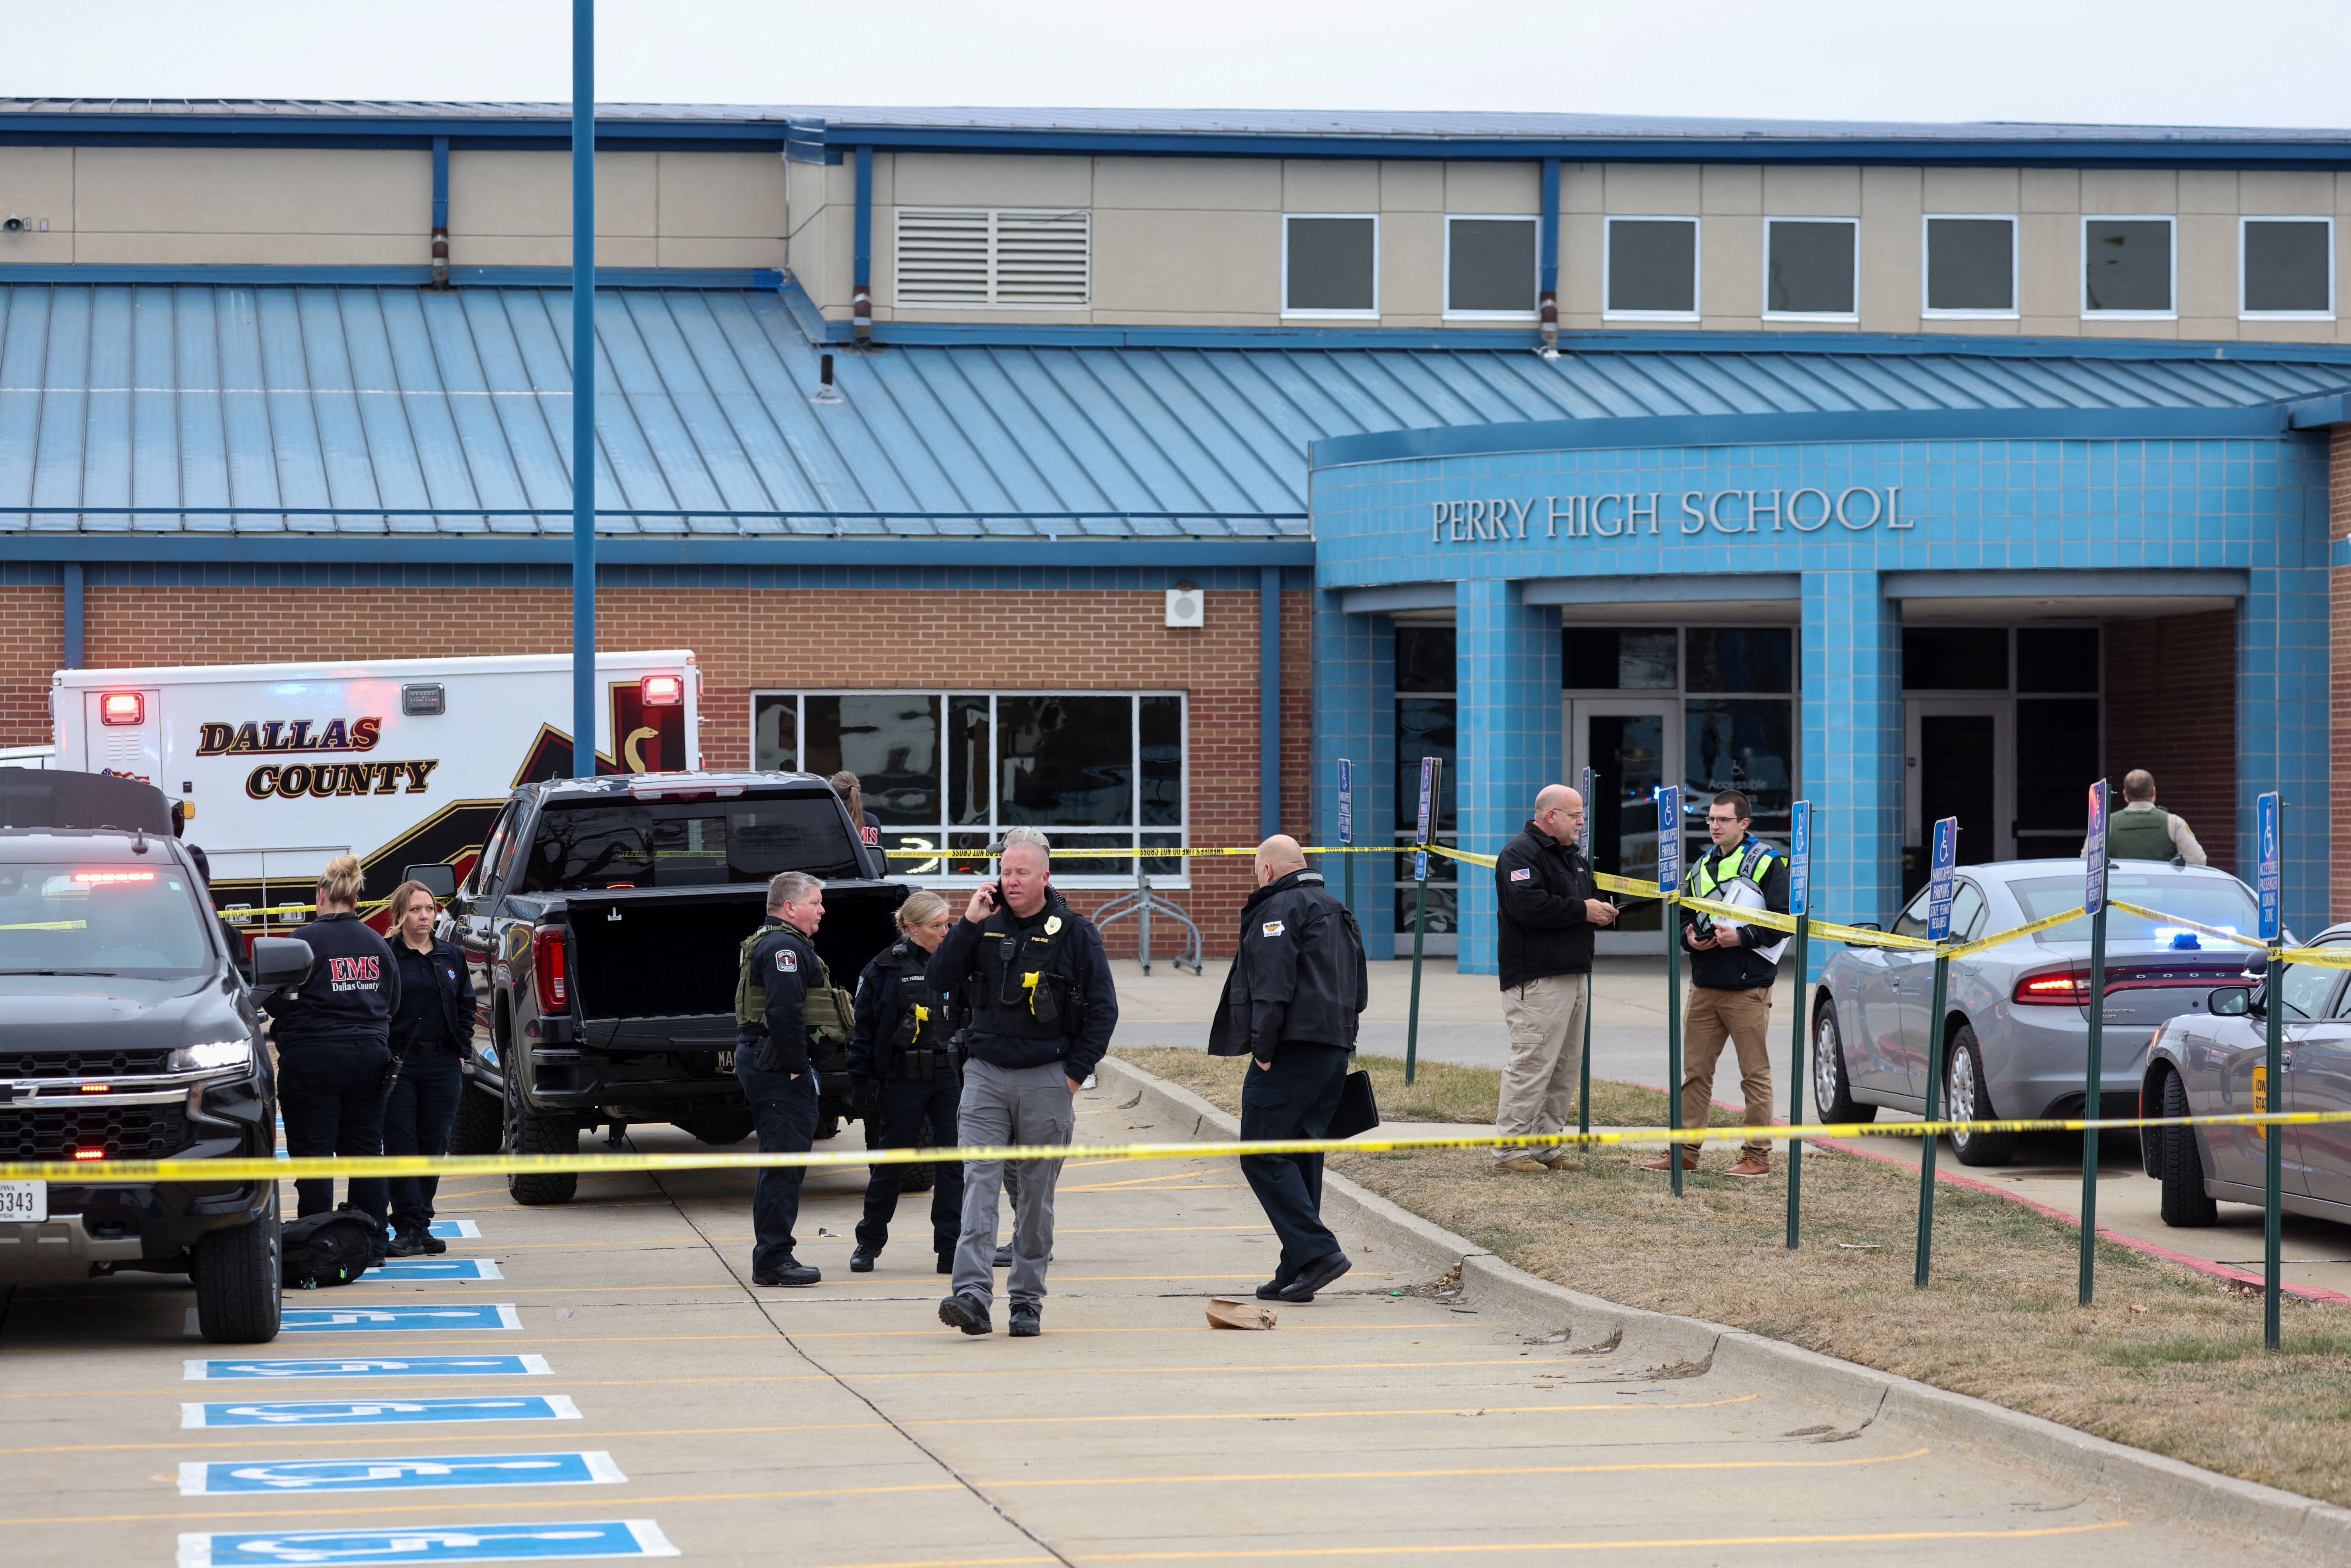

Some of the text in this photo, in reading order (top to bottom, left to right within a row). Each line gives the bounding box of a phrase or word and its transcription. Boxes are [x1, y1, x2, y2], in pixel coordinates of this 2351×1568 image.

[1432, 486, 1914, 542] PERRY HIGH SCHOOL
[196, 717, 382, 756] DALLAS
[246, 759, 439, 800] COUNTY
[1709, 779, 1768, 790] Accessible
[1660, 828, 1677, 843] HANDICAPPED
[1662, 843, 1676, 857] PARKING
[1669, 860, 1678, 871] PERMIT
[1743, 848, 1761, 874] EMA
[2090, 851, 2102, 870] PARKING
[1932, 865, 1953, 883] HANDICAPPED
[2260, 861, 2278, 876] ACCESSIBLE
[1662, 871, 1676, 883] REQUIRED
[2260, 876, 2278, 891] PASSENGER
[1933, 883, 1950, 900] PARKING
[2263, 892, 2275, 907] LOADING
[1930, 903, 1951, 917] STATE PERMIT
[2265, 908, 2273, 922] ZONE
[1931, 916, 1947, 929] REQUIRED
[329, 956, 379, 982] EMS
[332, 981, 380, 992] Dallas County
[718, 1051, 736, 1067] MA
[2256, 1079, 2266, 1093] IOW
